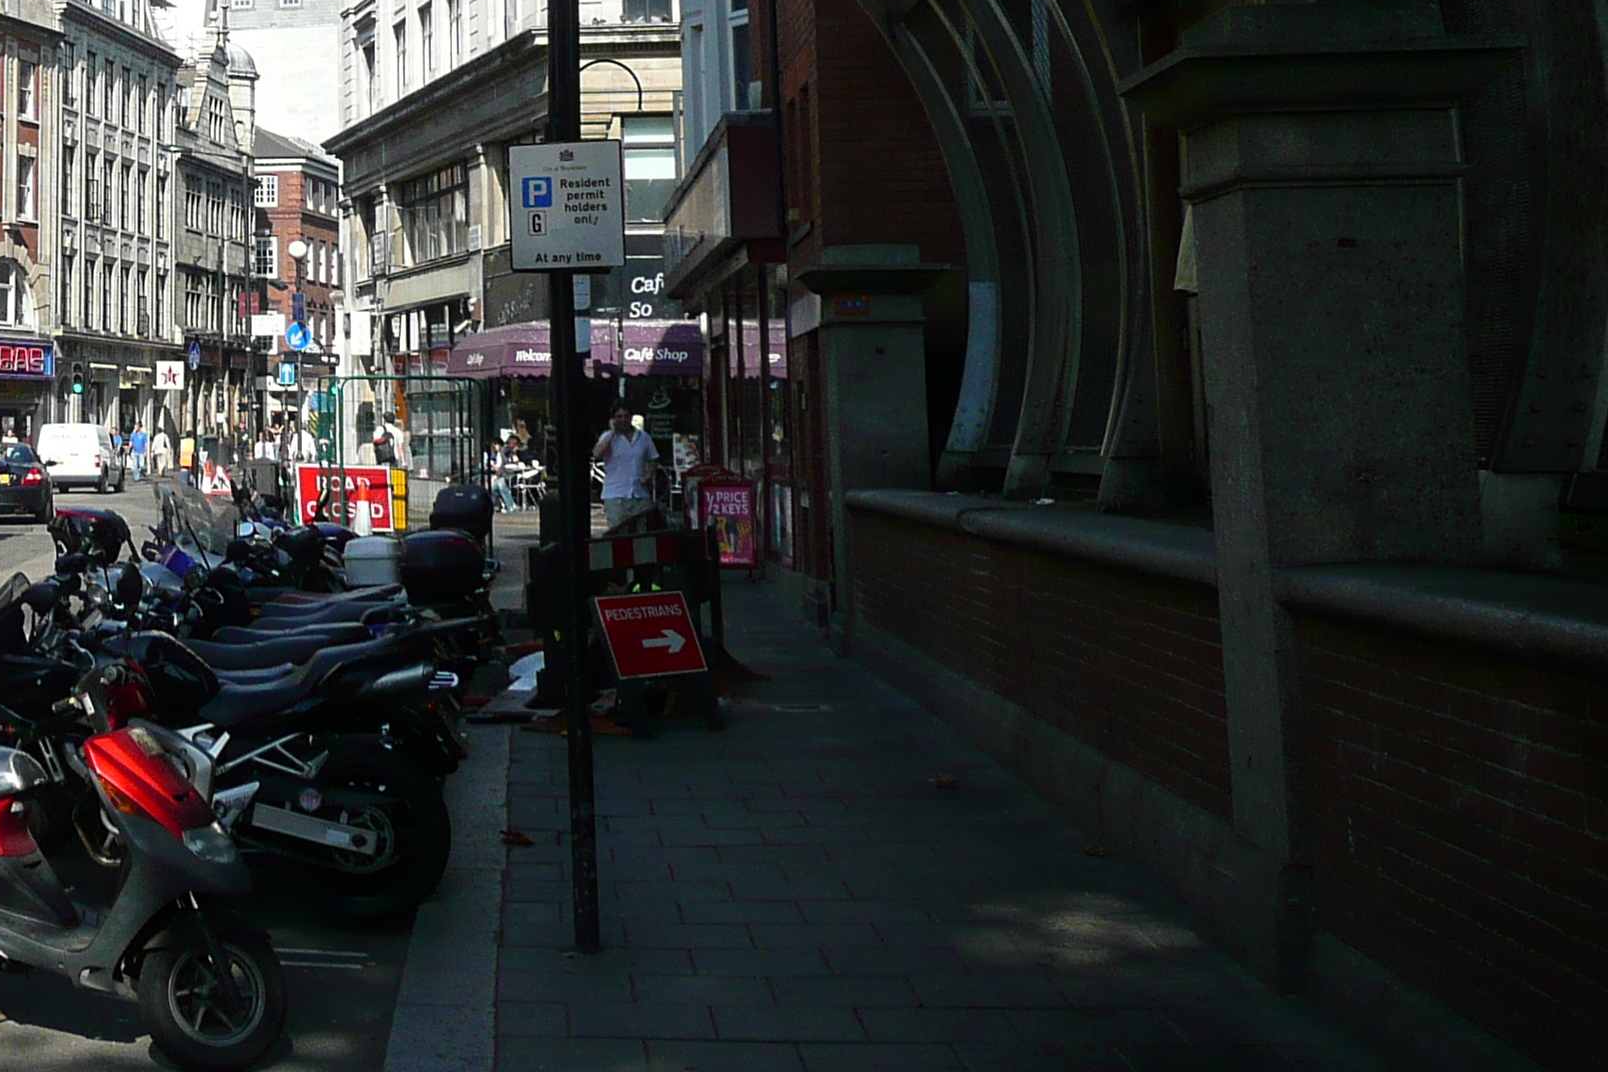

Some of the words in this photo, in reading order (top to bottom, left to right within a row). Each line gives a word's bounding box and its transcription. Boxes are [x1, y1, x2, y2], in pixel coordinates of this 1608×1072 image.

[560, 178, 611, 189] Resident
[528, 180, 548, 206] P
[566, 190, 605, 201] permit
[564, 203, 608, 213] holders
[532, 213, 542, 233] G
[574, 215, 599, 226] only
[535, 253, 549, 263] At
[552, 254, 572, 264] any
[576, 252, 602, 262] time
[515, 350, 552, 363] Welcom
[624, 347, 655, 364] Café
[655, 348, 688, 364] Shop
[316, 475, 371, 492] ROAD
[716, 491, 748, 503] PRICE
[306, 500, 384, 519] COSD
[721, 503, 749, 515] KEYS
[604, 604, 682, 621] PEDESTRIANS
